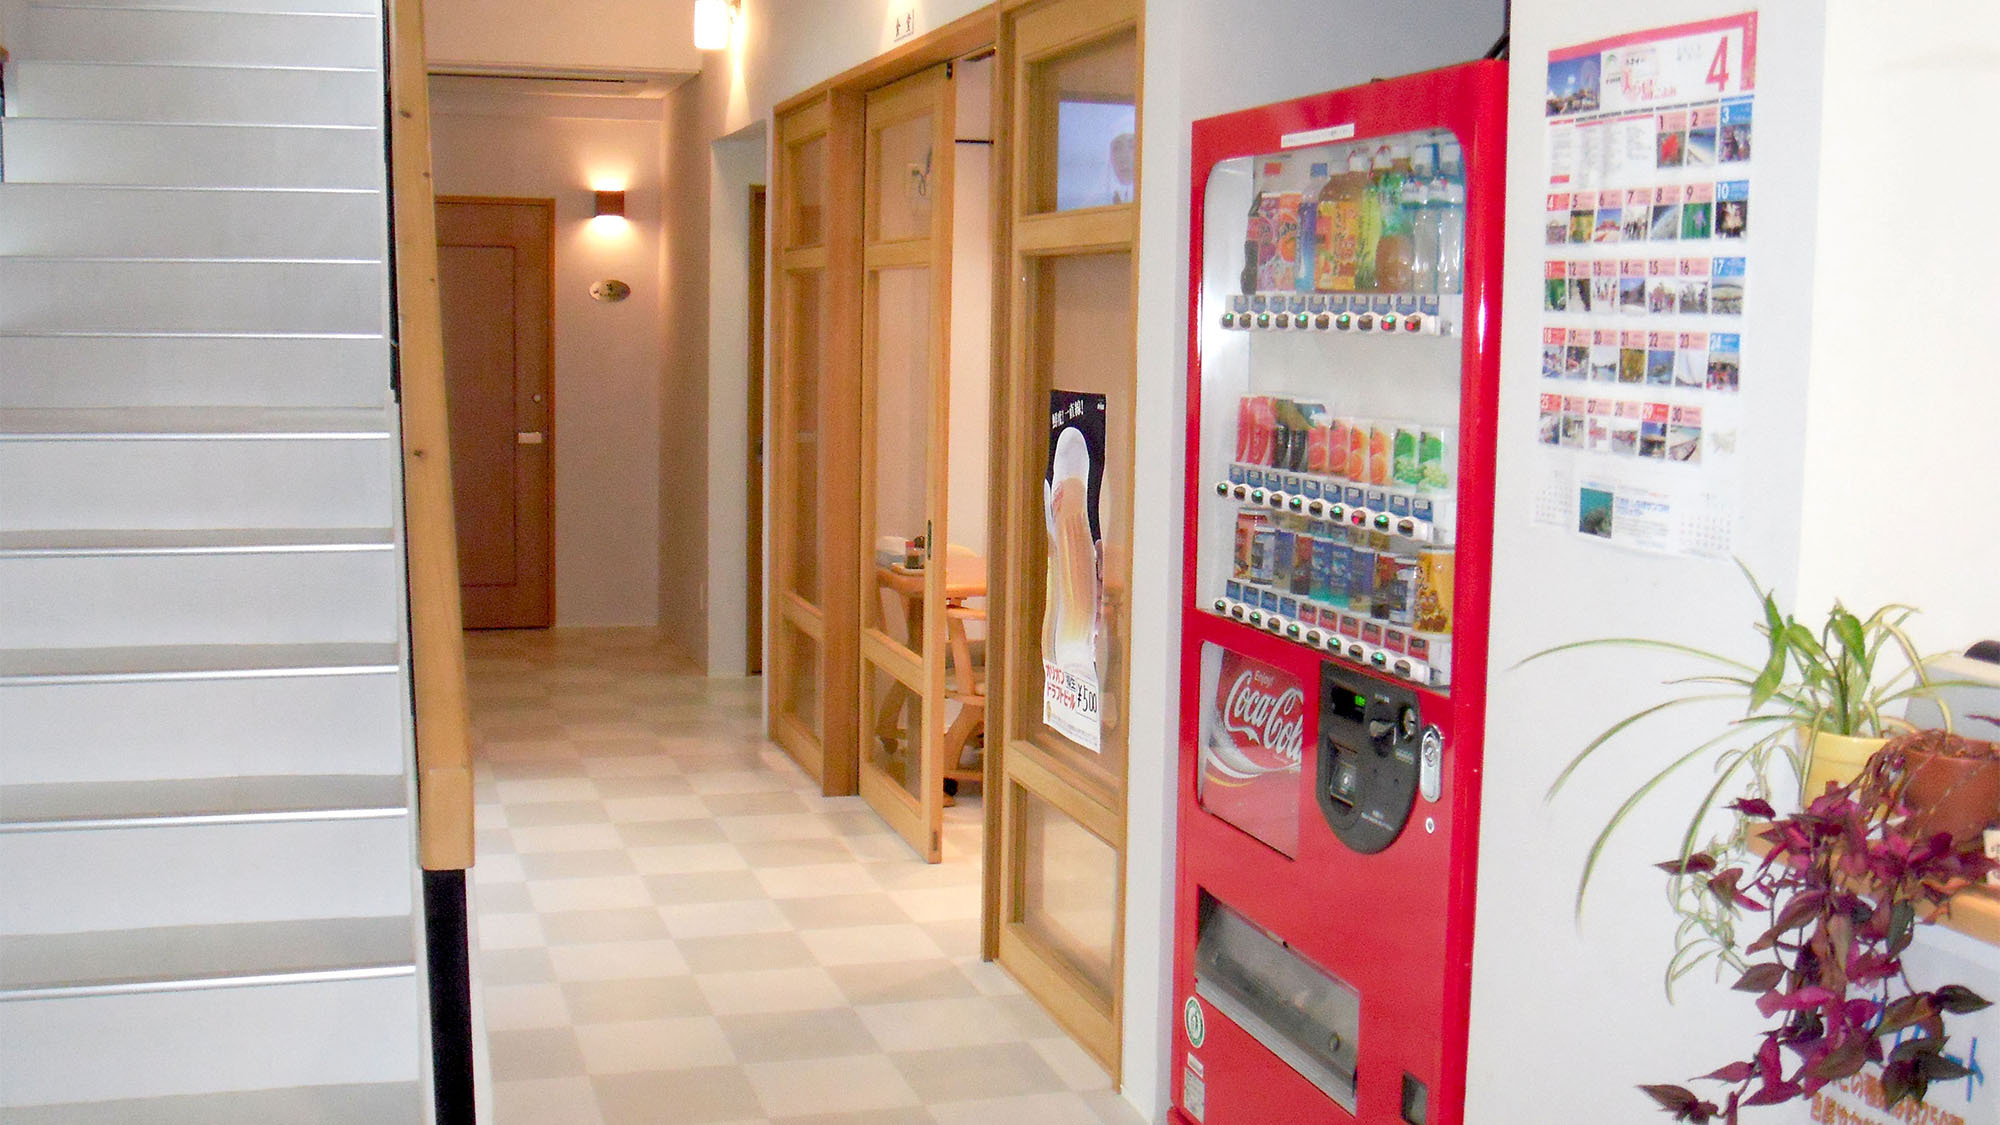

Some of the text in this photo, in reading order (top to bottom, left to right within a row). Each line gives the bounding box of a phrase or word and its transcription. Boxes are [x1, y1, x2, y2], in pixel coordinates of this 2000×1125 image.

[1706, 36, 1728, 92] 4
[1692, 112, 1698, 127] 2
[1722, 107, 1729, 124] 3
[1628, 190, 1634, 204] 7
[1656, 188, 1662, 202] 8
[1687, 185, 1693, 201] 9
[1717, 183, 1729, 199] 10
[1568, 261, 1576, 276] 12
[1620, 261, 1629, 274] 14
[1649, 260, 1658, 275] 15
[1680, 259, 1690, 275] 16
[1713, 259, 1724, 275] 17
[1649, 332, 1658, 347] 22
[1680, 333, 1689, 348] 23
[1587, 400, 1596, 413] 27
[1673, 407, 1682, 422] 30
